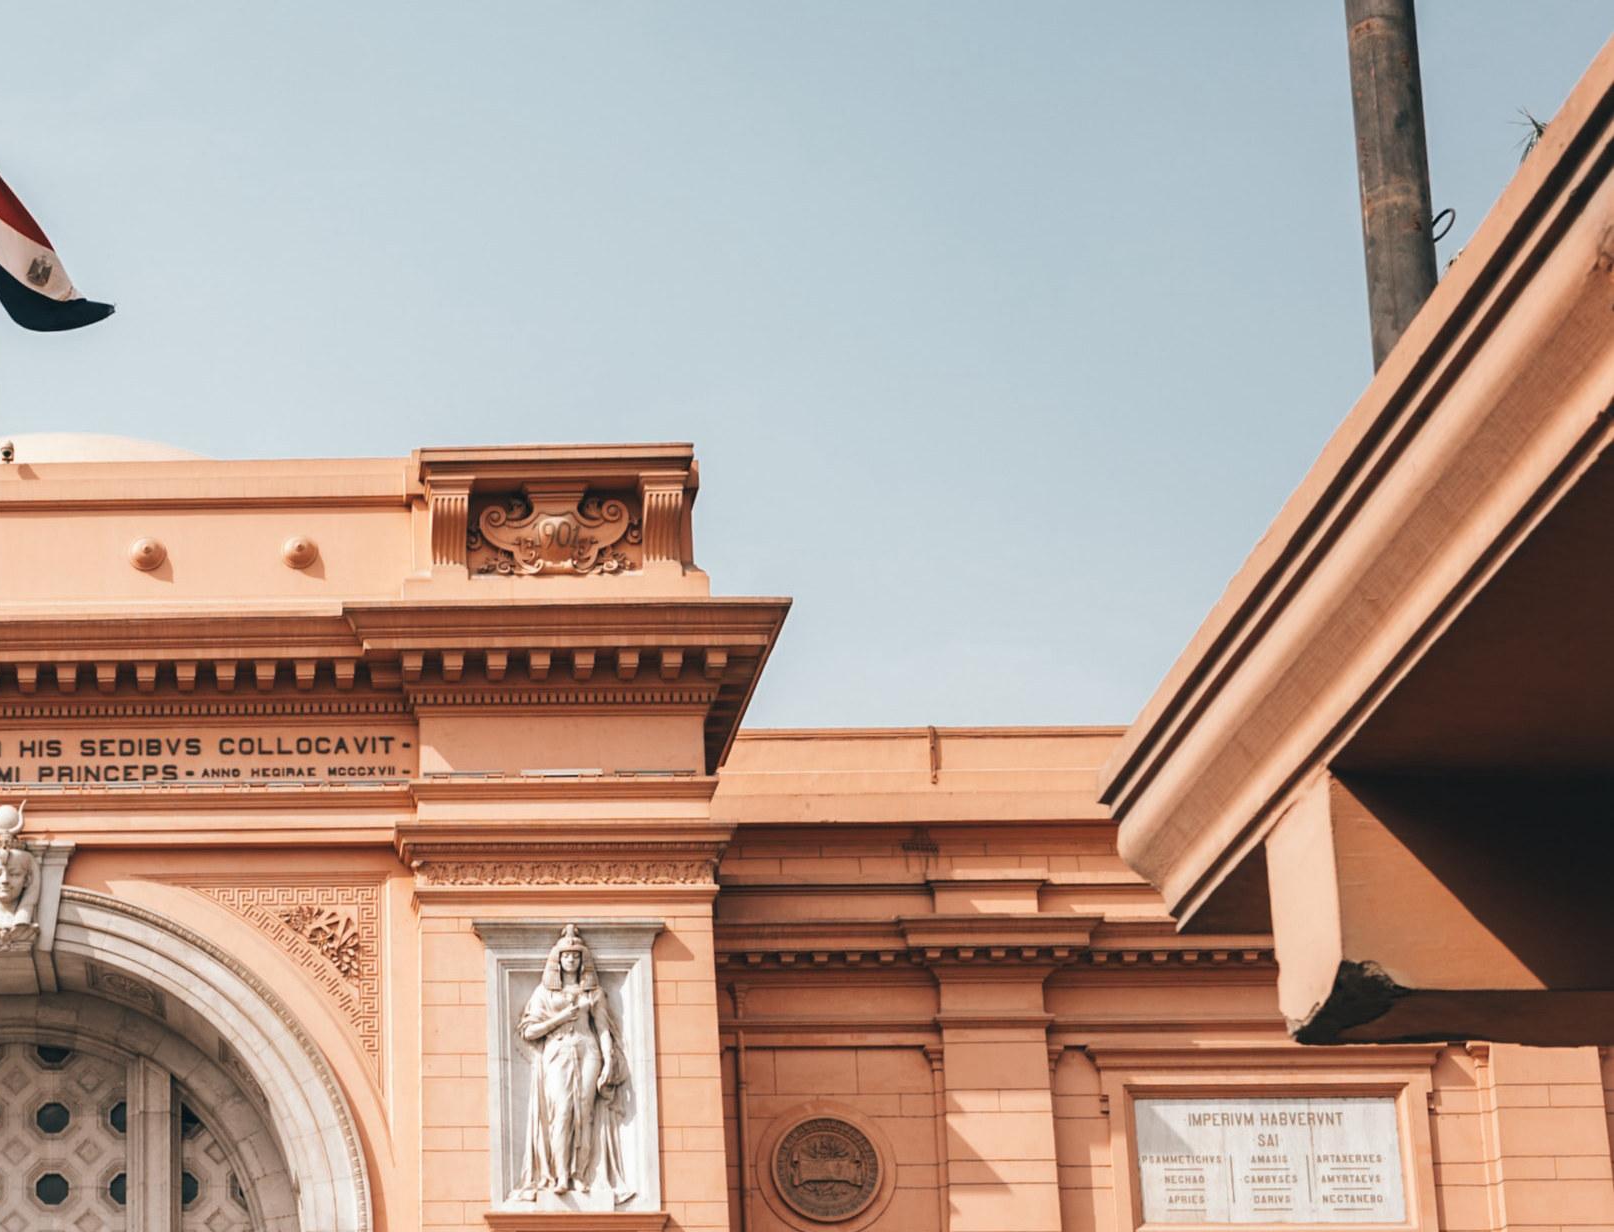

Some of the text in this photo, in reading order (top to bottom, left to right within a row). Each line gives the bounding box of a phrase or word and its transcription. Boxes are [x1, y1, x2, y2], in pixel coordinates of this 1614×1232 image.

[20, 740, 62, 757] HIS
[80, 738, 201, 756] SEDIBVS
[219, 736, 395, 755] COLLOCAVIT
[38, 765, 178, 782] PRINCEPS
[202, 768, 241, 778] ANNO
[1188, 1112, 1343, 1127] IMPERIVM HABVERVNT
[1257, 1134, 1279, 1148] SAI
[1250, 1156, 1288, 1164] AMASIS
[1168, 1195, 1205, 1204] APRIES
[1253, 1195, 1291, 1204] DARIVS
